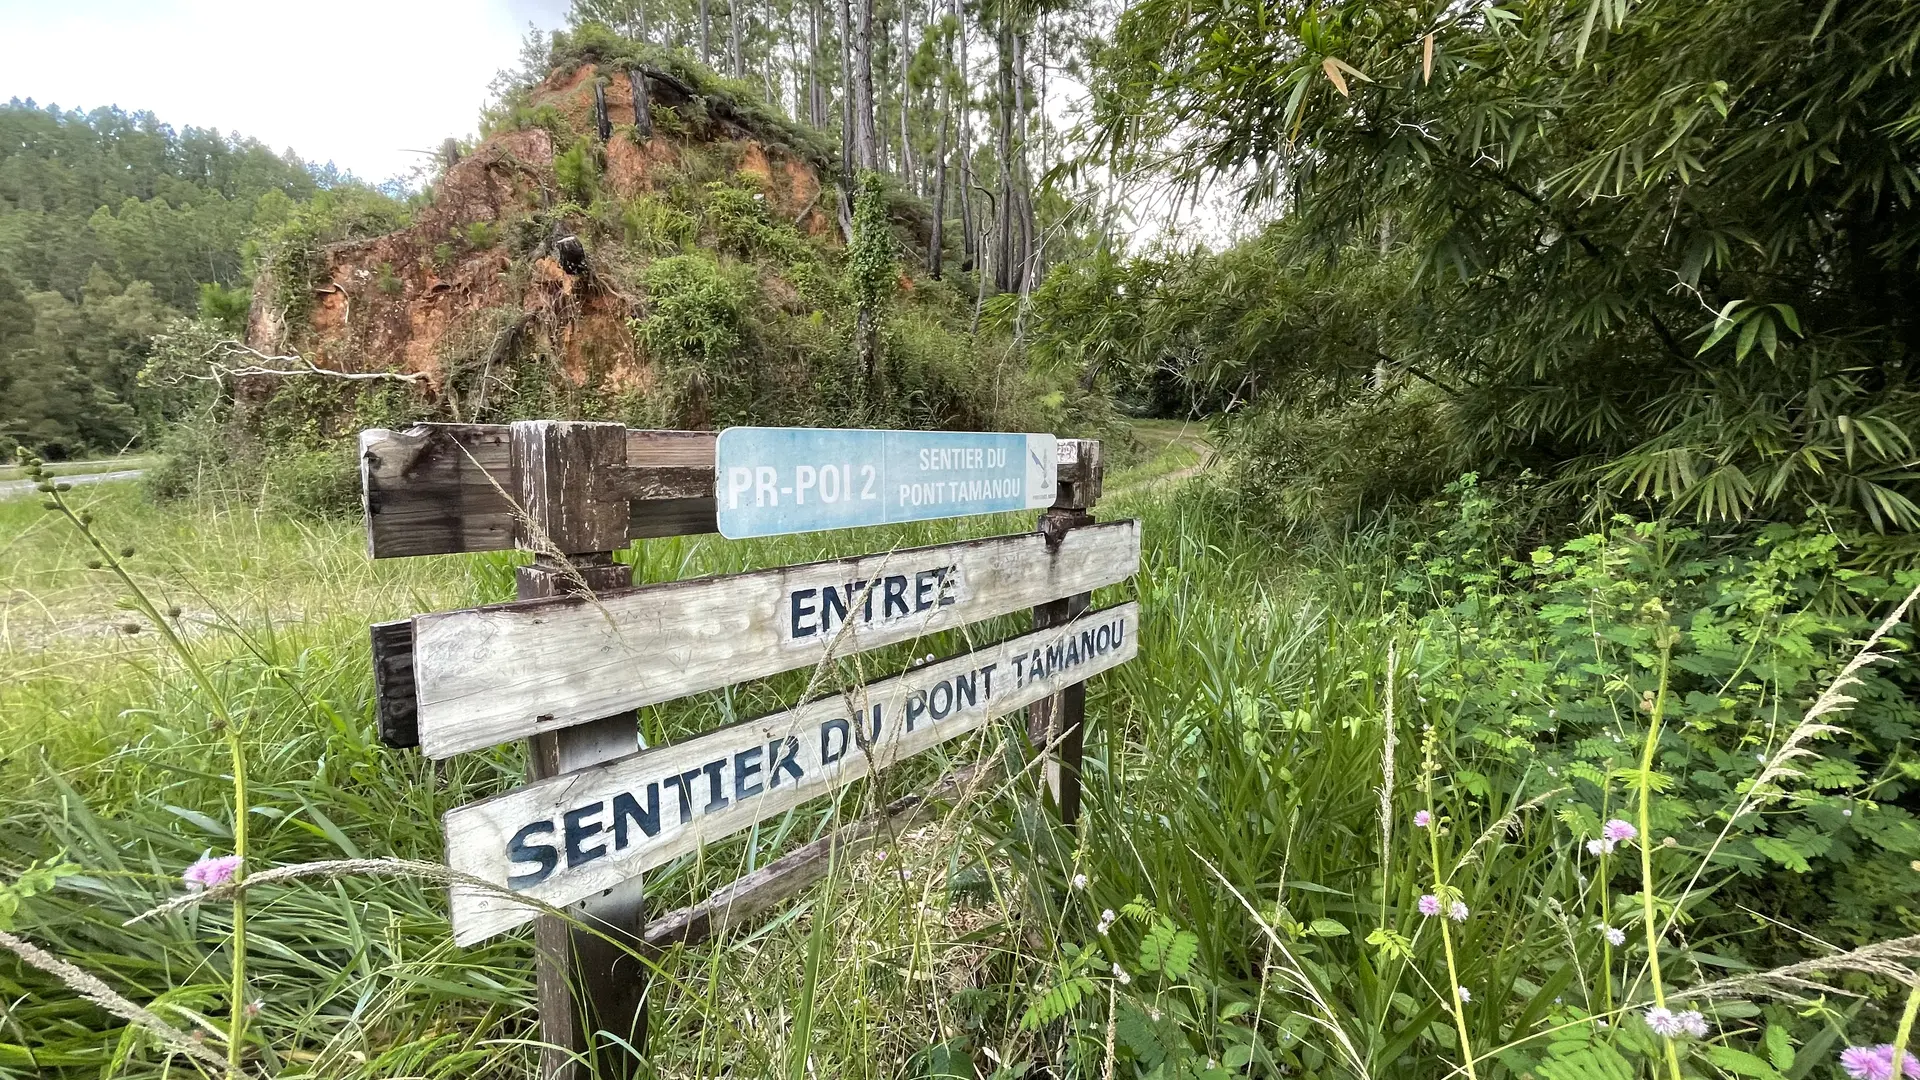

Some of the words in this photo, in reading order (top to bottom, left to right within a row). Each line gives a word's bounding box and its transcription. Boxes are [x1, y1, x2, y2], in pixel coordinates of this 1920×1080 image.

[919, 449, 984, 471] SENTIER
[987, 447, 1006, 469] DU
[728, 464, 852, 510] PR-POI
[860, 464, 877, 500] 2
[899, 481, 945, 507] PONT
[948, 477, 1021, 504] TAMANOU
[505, 735, 805, 891] SENTIER
[821, 703, 882, 766] DU
[906, 663, 998, 732] PONT
[1011, 618, 1125, 689] TAMANOU
